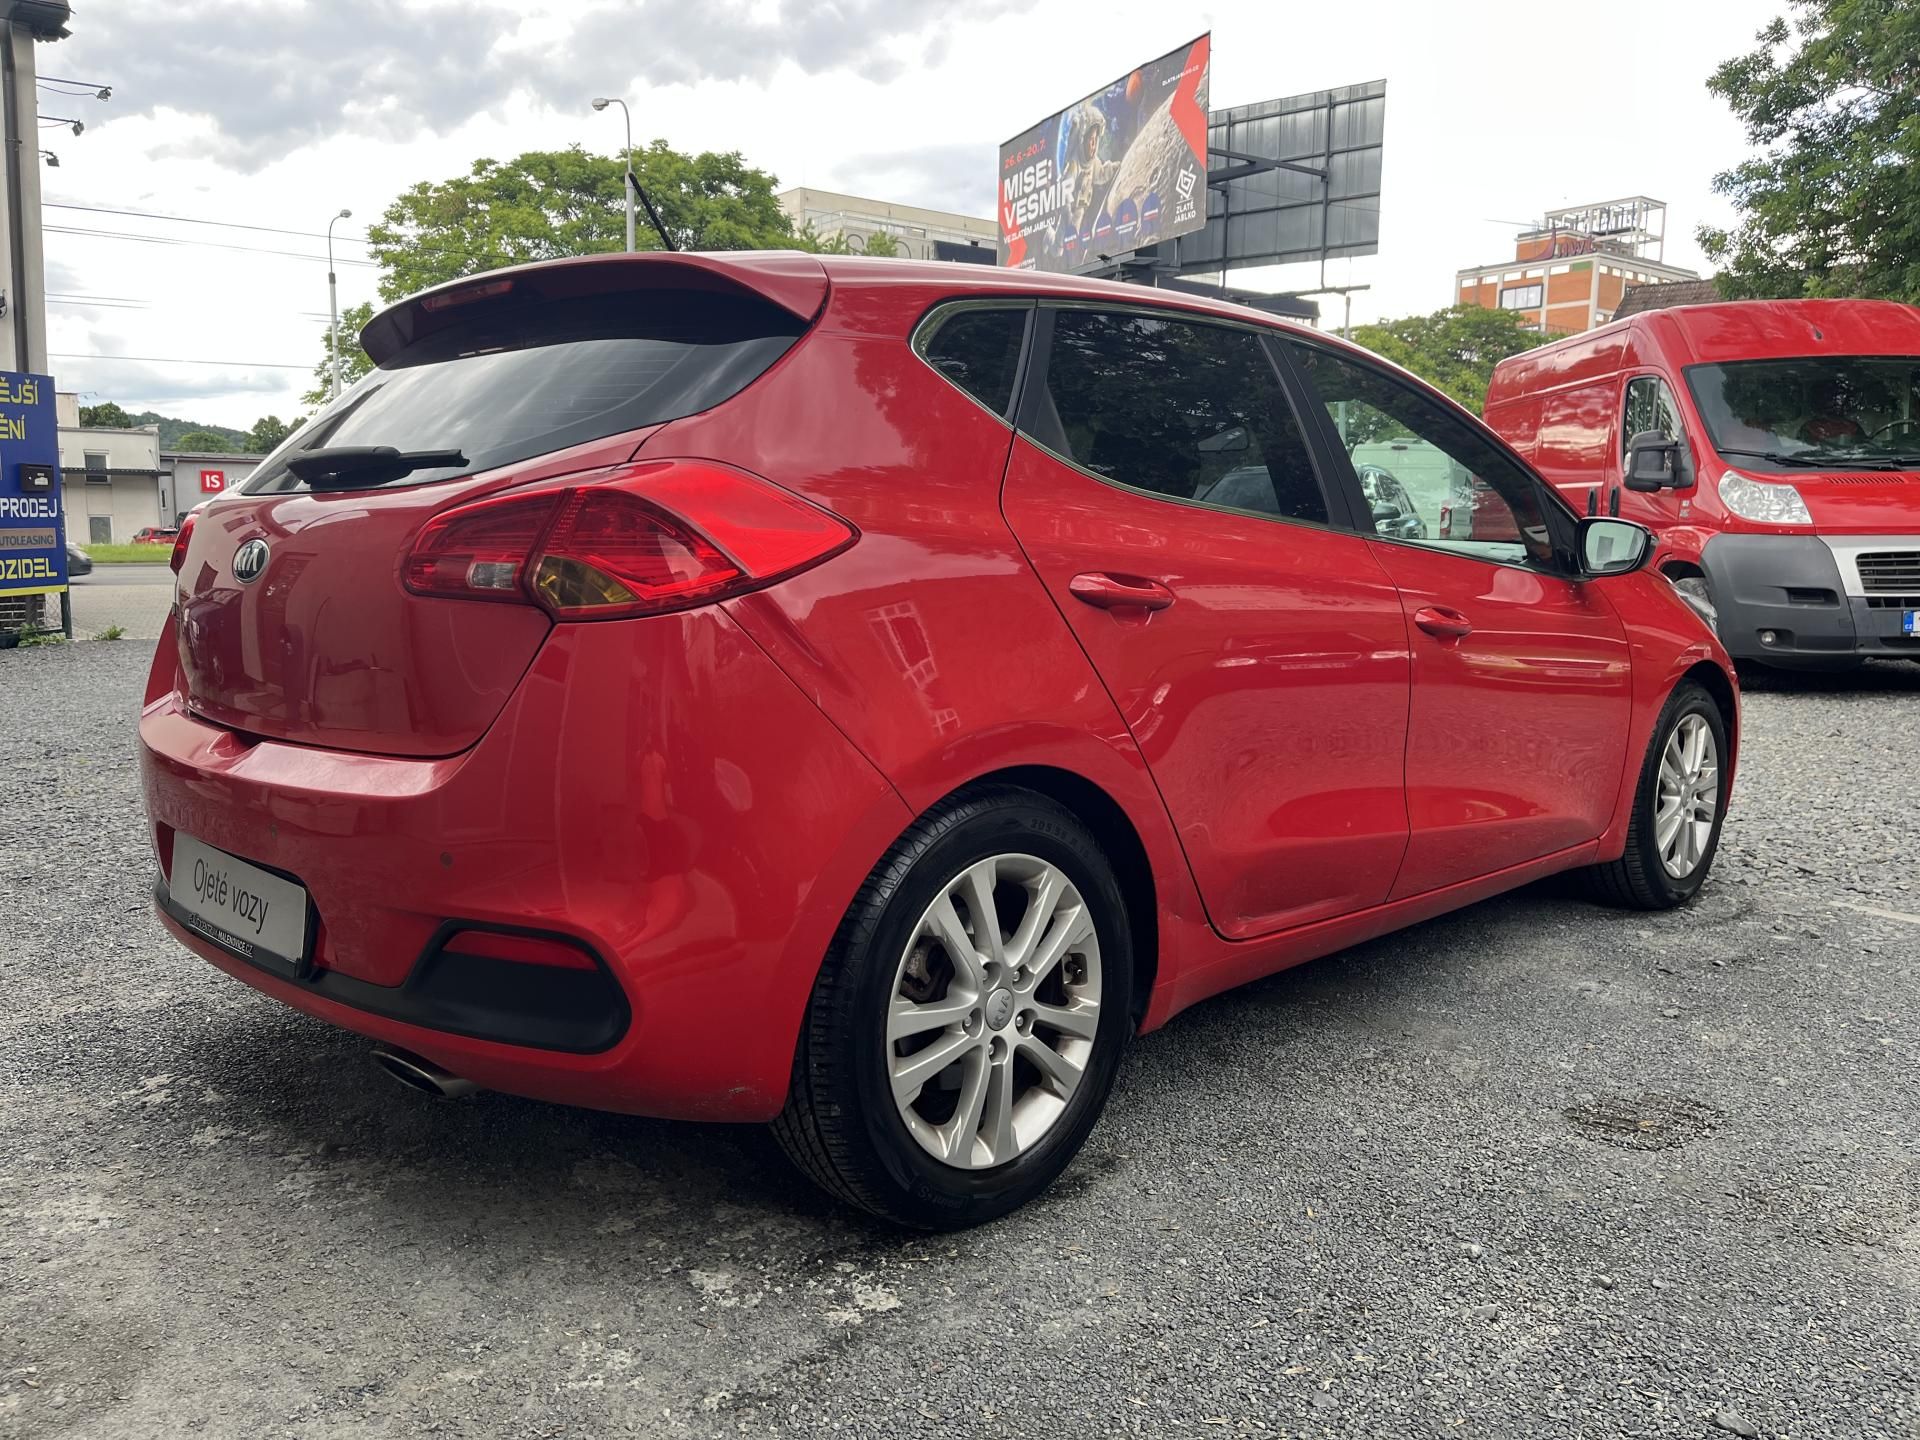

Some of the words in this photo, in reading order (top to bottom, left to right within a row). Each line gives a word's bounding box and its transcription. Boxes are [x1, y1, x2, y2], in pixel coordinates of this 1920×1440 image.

[1004, 159, 1052, 203] MISE:
[1004, 174, 1075, 229] VESMÍR
[205, 474, 221, 488] IS
[0, 498, 58, 518] PRODEJ
[194, 858, 228, 906] Ojeté
[232, 886, 269, 934] vozy
